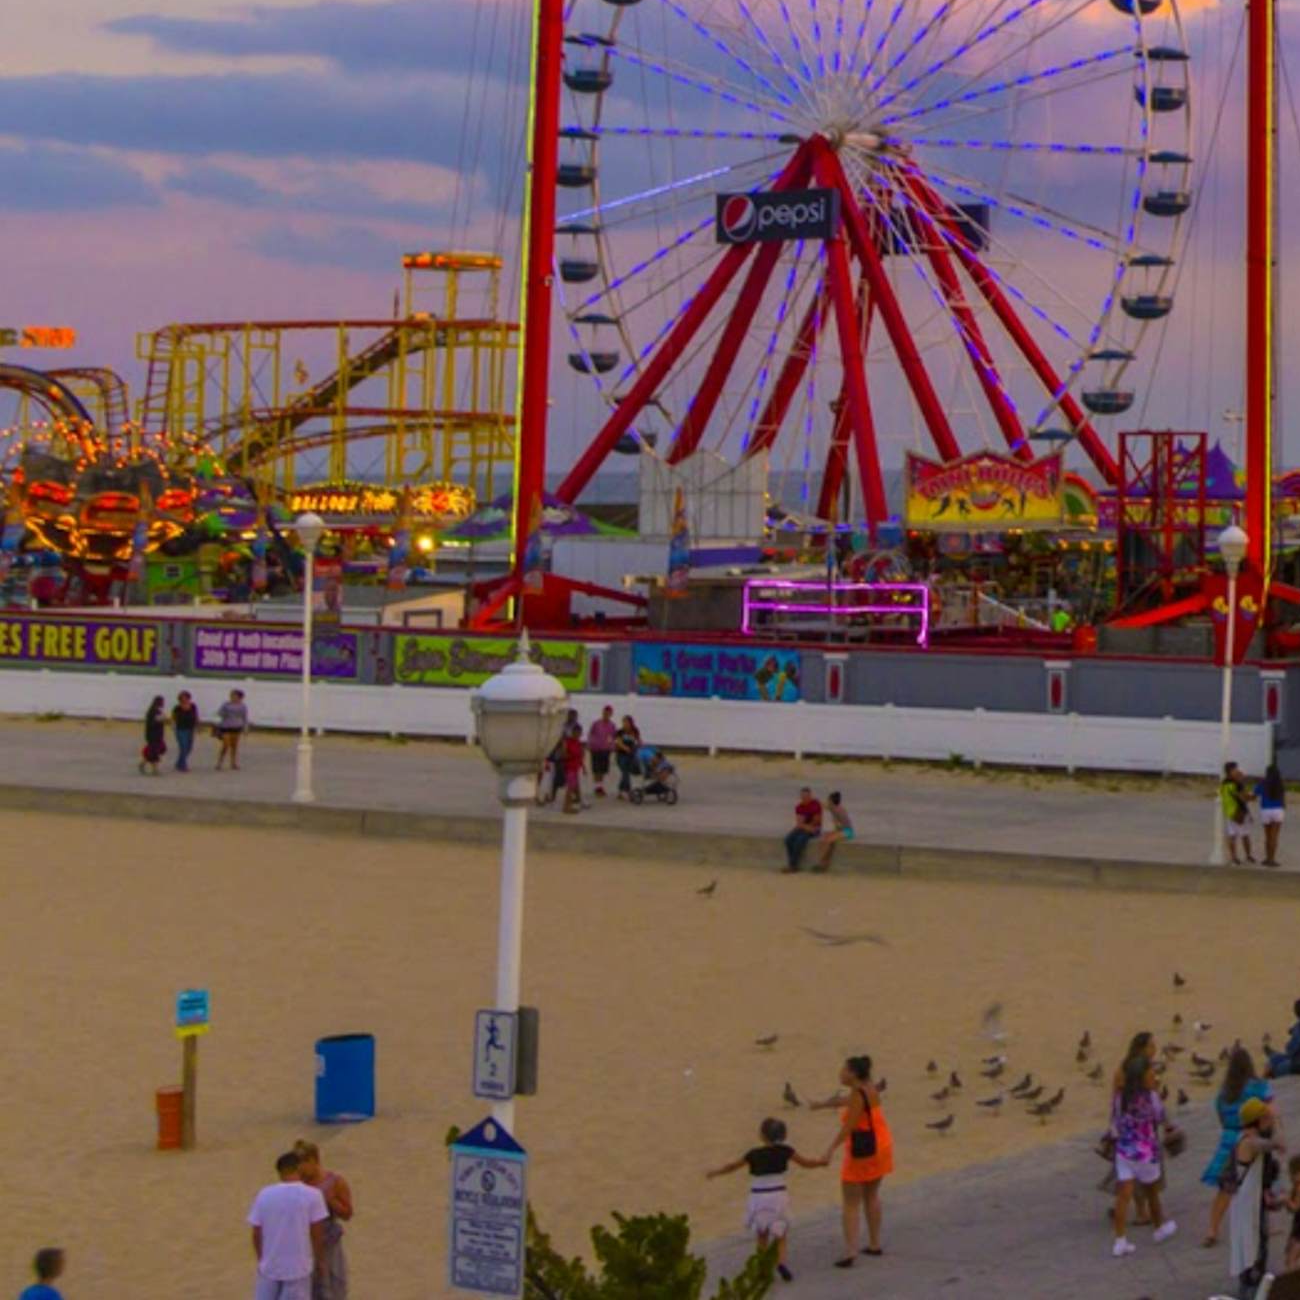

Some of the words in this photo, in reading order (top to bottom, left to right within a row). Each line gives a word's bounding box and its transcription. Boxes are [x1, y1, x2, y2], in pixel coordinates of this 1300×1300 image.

[757, 197, 826, 232] pepsi
[29, 623, 88, 659] FREE
[94, 627, 156, 664] GOLF
